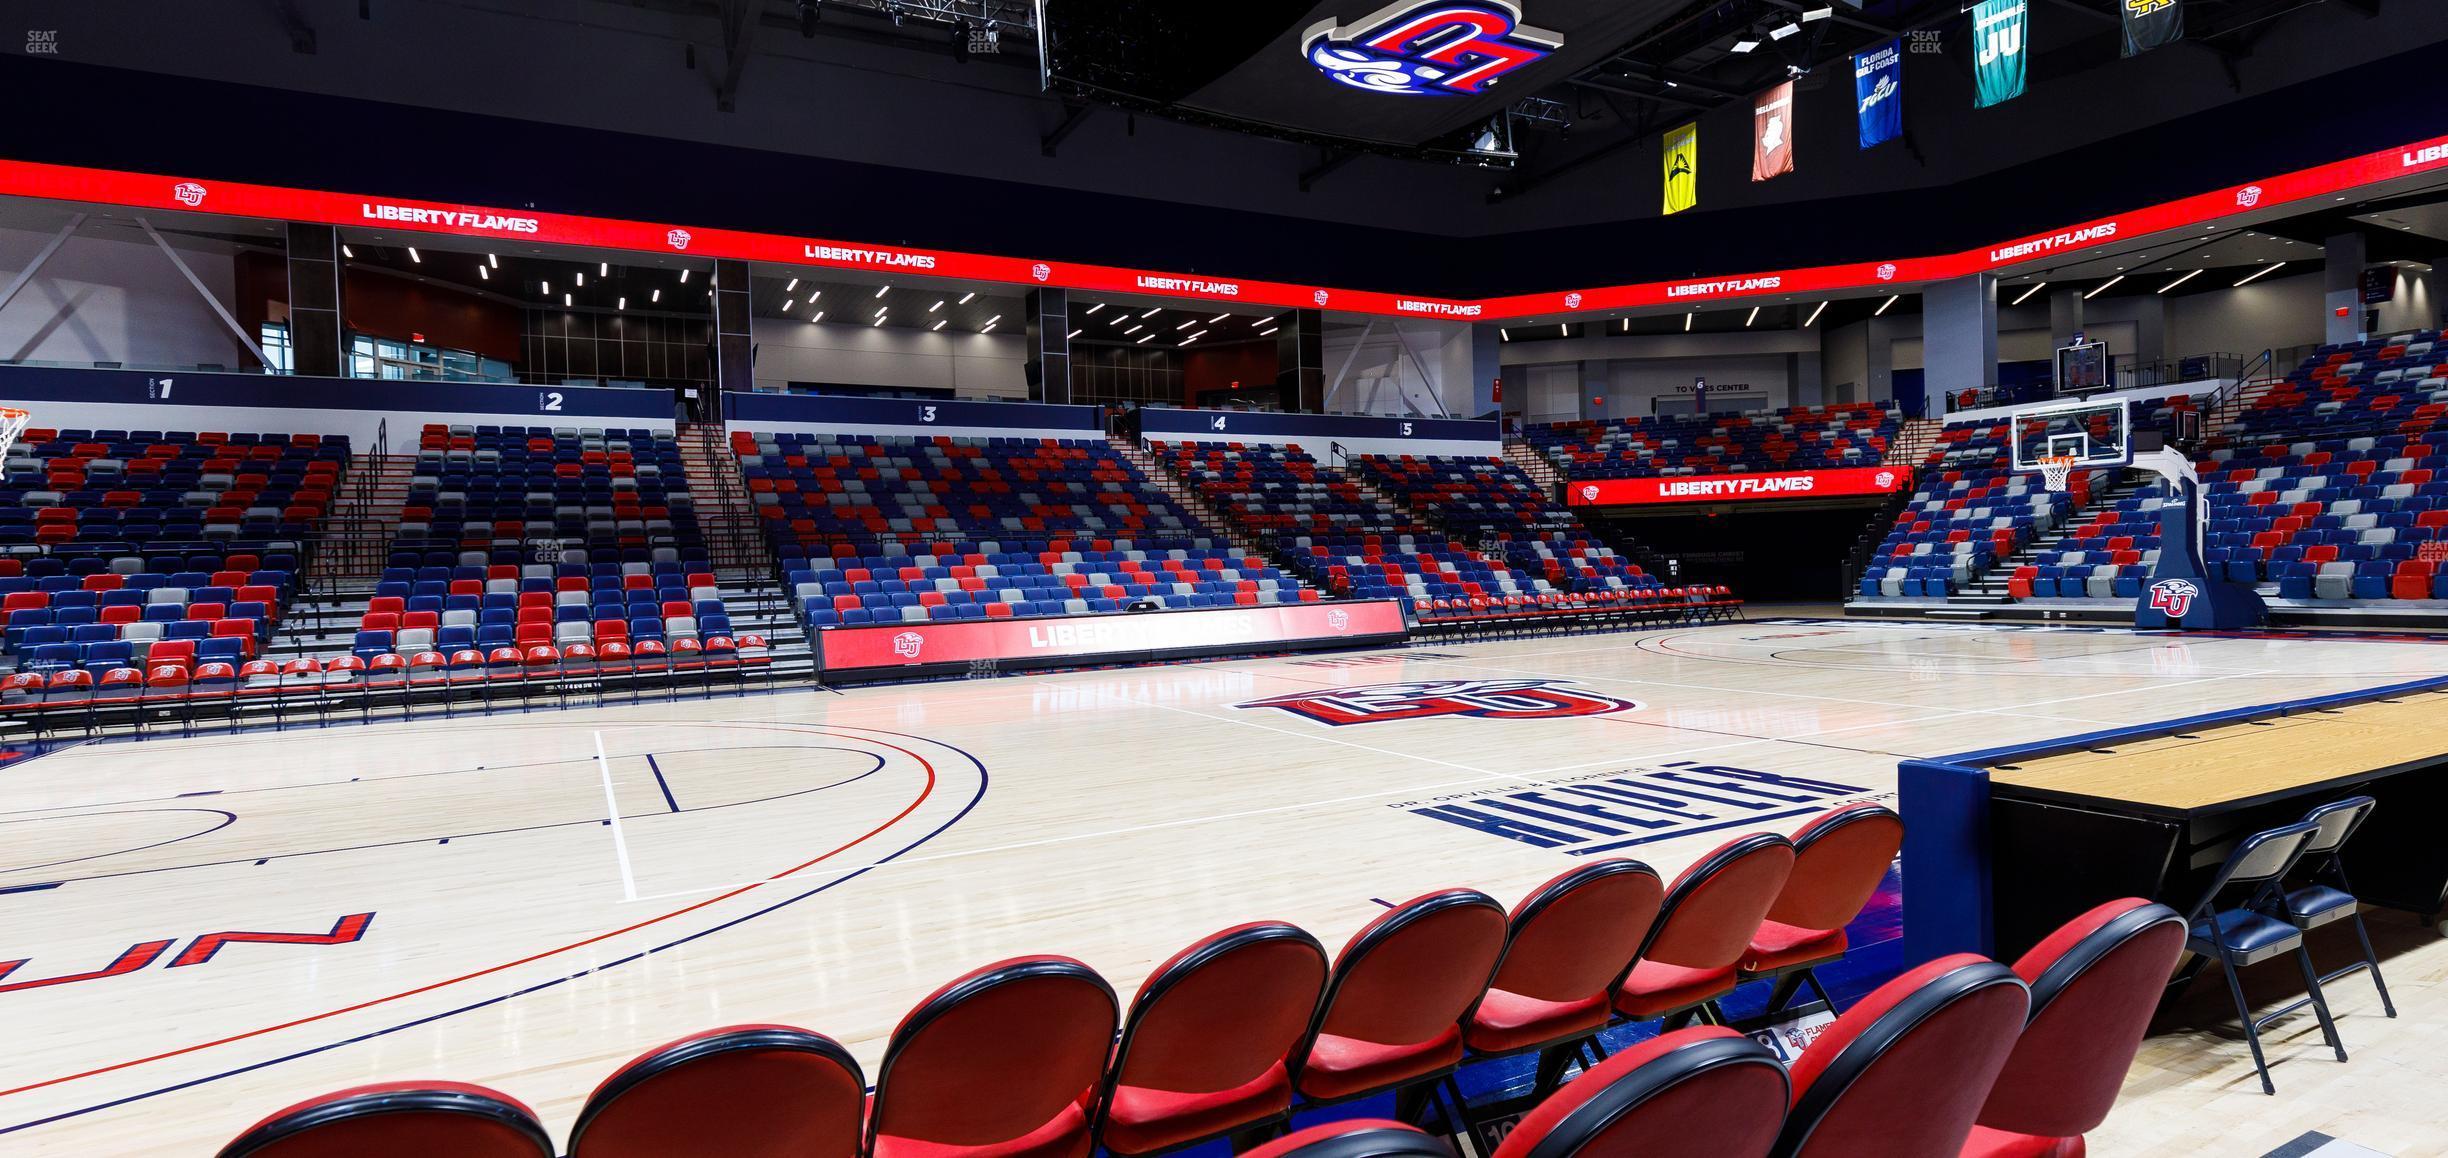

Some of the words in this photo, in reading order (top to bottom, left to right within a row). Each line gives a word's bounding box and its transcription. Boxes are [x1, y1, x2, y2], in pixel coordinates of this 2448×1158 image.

[1979, 23, 2021, 66] JU
[1856, 64, 1875, 78] GULF
[1875, 53, 1899, 70] COAST
[1861, 47, 1893, 67] FLORIDA
[363, 203, 457, 226] LIBERTY
[458, 211, 538, 233] FLAMES
[1990, 236, 2054, 262] LIBERTY
[2053, 222, 2117, 247] FLAMES
[805, 245, 875, 262] LIBERTY
[875, 251, 936, 269] FLAMES
[1137, 276, 1191, 291] LIBERTY
[1191, 281, 1238, 295] FLAMES
[1667, 281, 1727, 297] LIBERTY
[1726, 276, 1781, 292] FLAMES
[1397, 300, 1441, 314] LIBERTY
[1440, 304, 1481, 316] FLAMES
[2075, 337, 2083, 347] 7
[159, 379, 173, 399] 1
[1689, 385, 1714, 393] VES
[1716, 383, 1750, 392] CENTER
[1697, 381, 1703, 389] 6
[545, 392, 563, 411] 2
[923, 406, 937, 422] 3
[1214, 416, 1226, 430] 4
[1403, 422, 1412, 436] 5
[1660, 480, 1740, 497] LIBERTY
[1739, 476, 1814, 493] FLAMES
[2150, 579, 2198, 617] LU
[1387, 800, 1429, 809] DR.
[1433, 785, 1522, 803] ORVILLE
[1547, 767, 1651, 785] FLORENCE
[1805, 1021, 1834, 1036] FLAME
